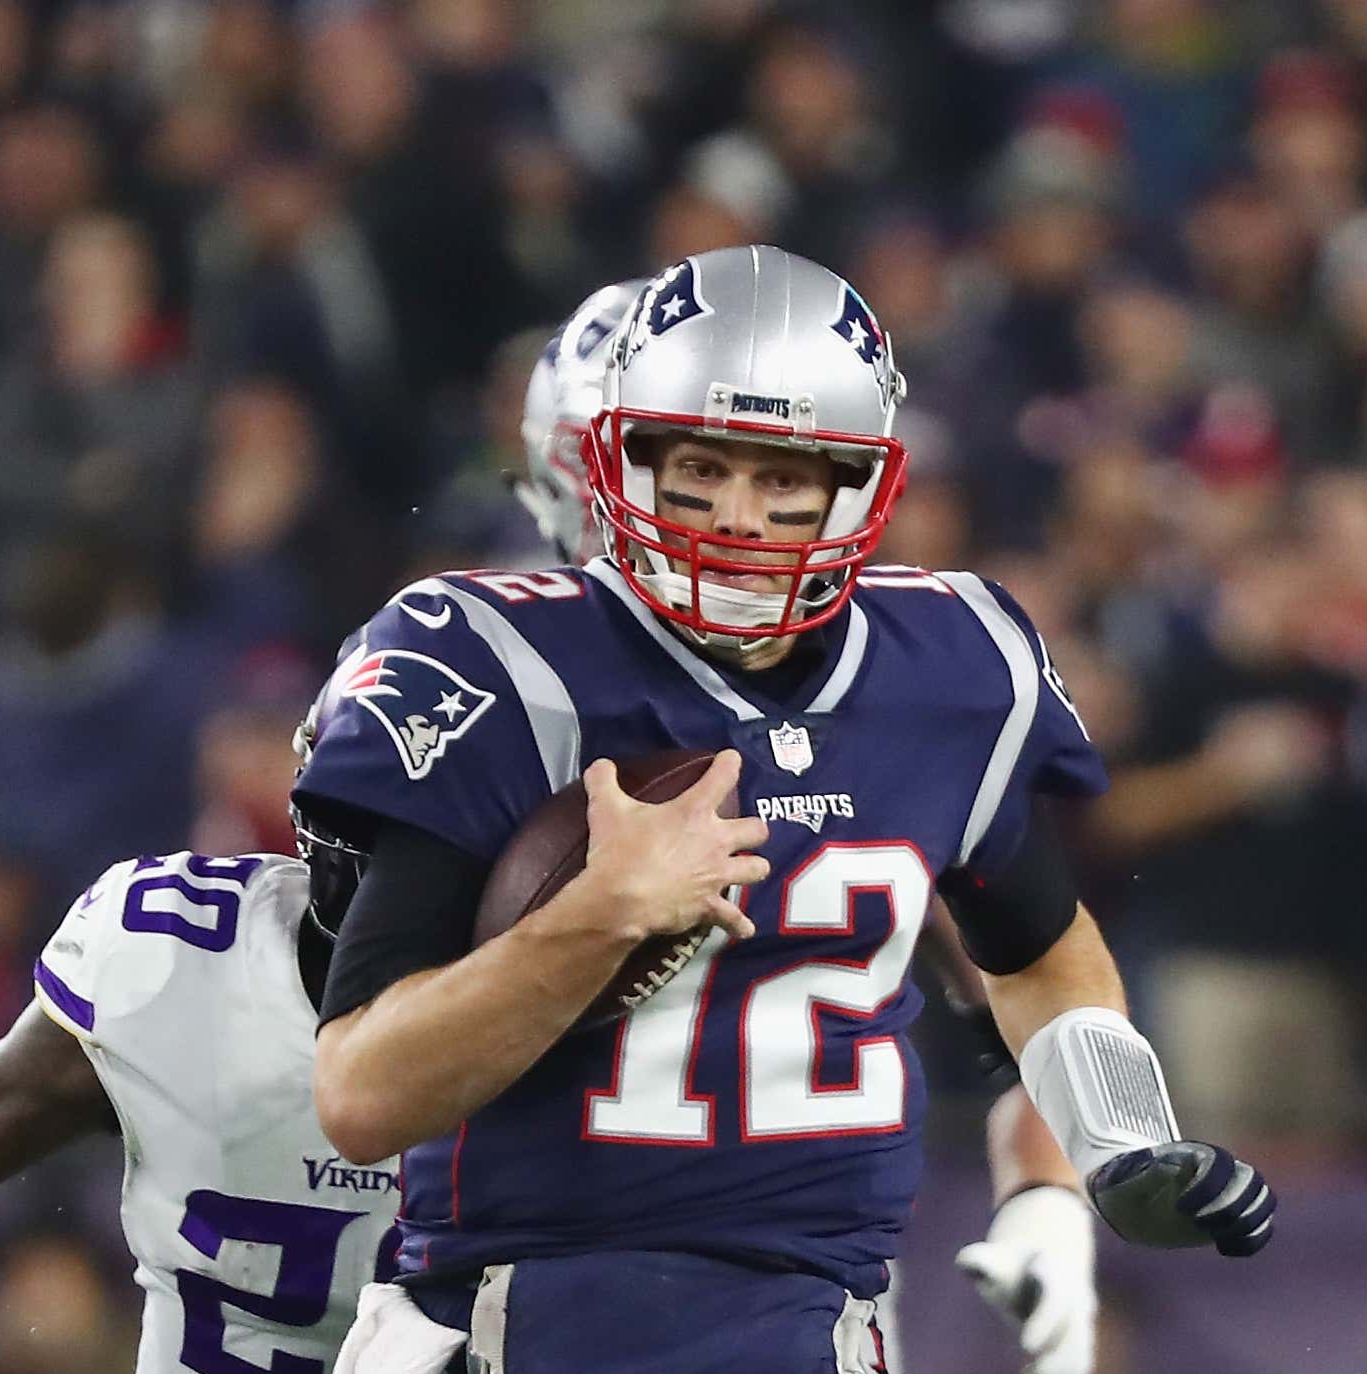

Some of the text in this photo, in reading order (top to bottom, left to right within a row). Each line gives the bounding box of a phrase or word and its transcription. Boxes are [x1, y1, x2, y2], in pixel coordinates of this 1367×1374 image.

[730, 391, 791, 420] PATRIOTS
[754, 793, 855, 824] PATRIOTS
[580, 839, 936, 1147] 12
